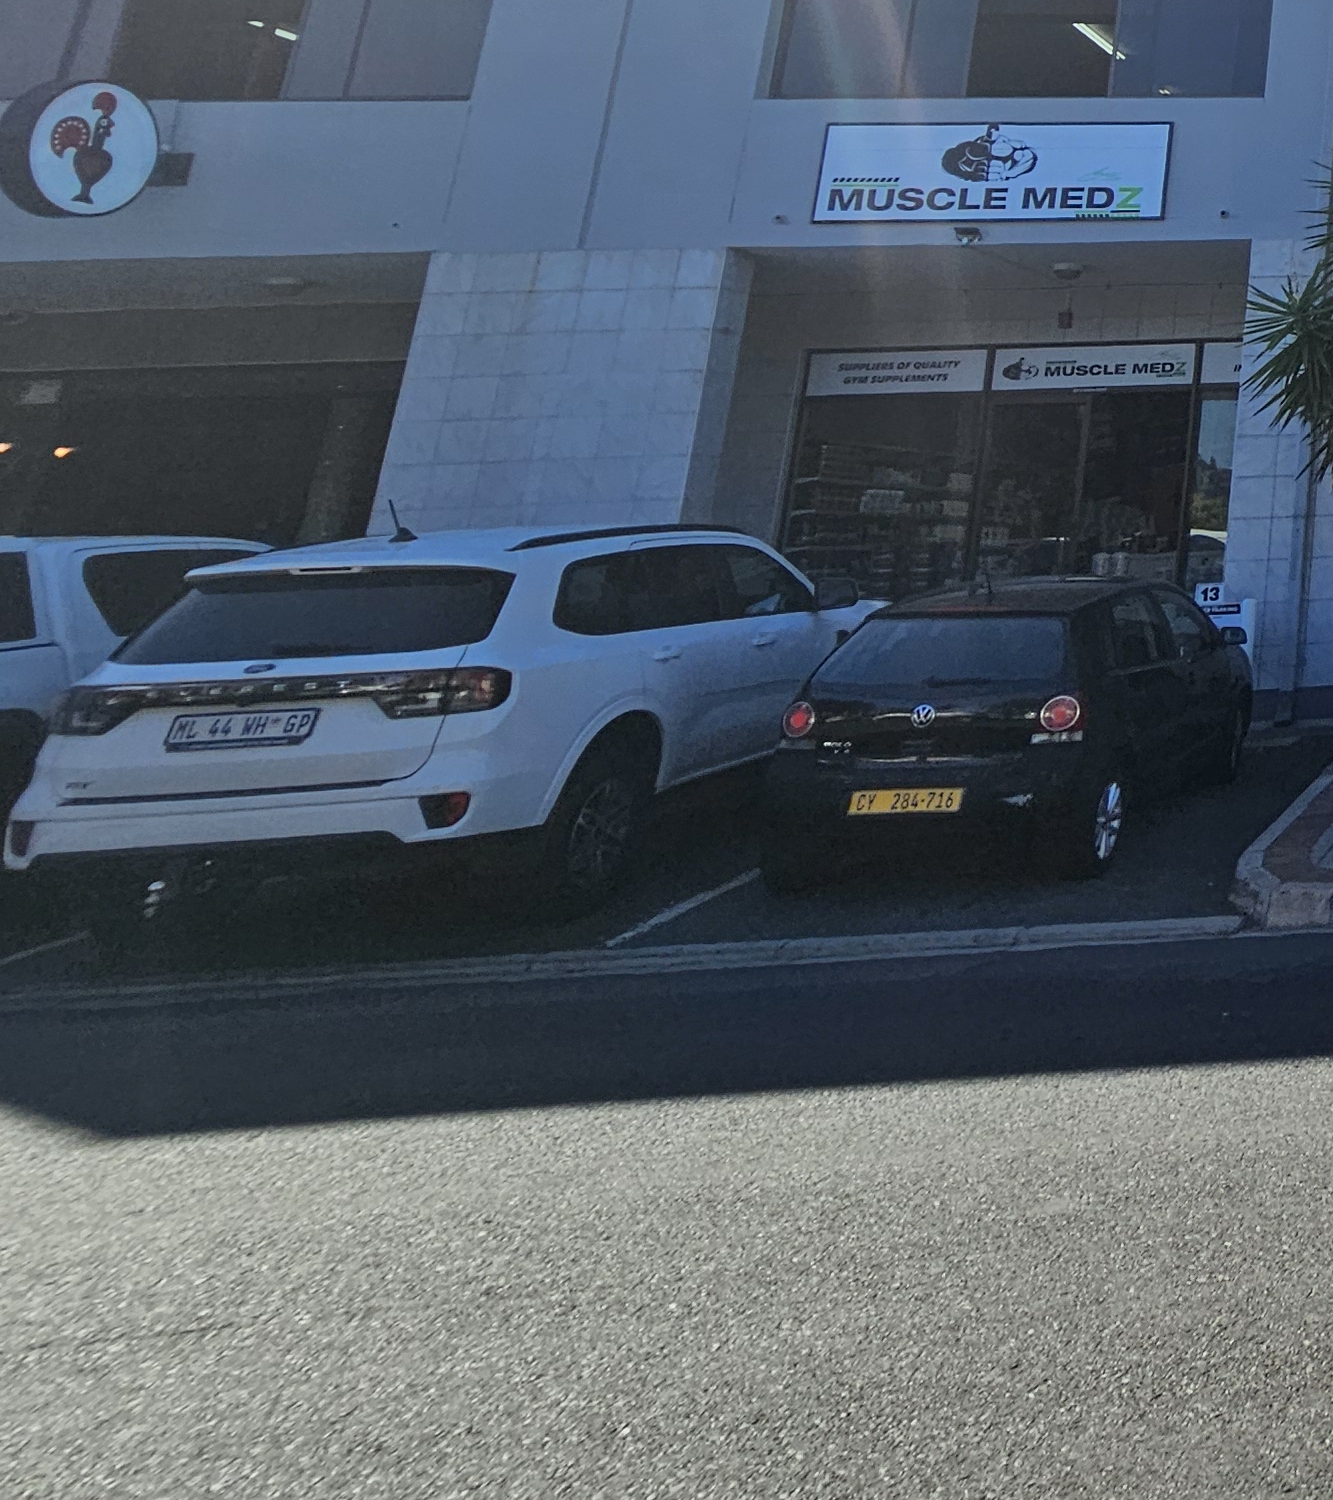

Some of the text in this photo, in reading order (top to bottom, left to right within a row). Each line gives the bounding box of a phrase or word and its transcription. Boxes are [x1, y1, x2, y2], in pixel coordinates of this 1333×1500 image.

[827, 187, 1144, 212] MUSCLE MEDZ
[838, 360, 961, 372] SUPPLIERS OF QUALITY
[1044, 361, 1188, 377] MUSCLE MEDZ
[870, 373, 949, 384] SUPPLEMENTS
[1201, 587, 1220, 602] 13
[208, 718, 232, 736] 44
[283, 714, 311, 735] GP
[890, 790, 954, 811] 284-716
